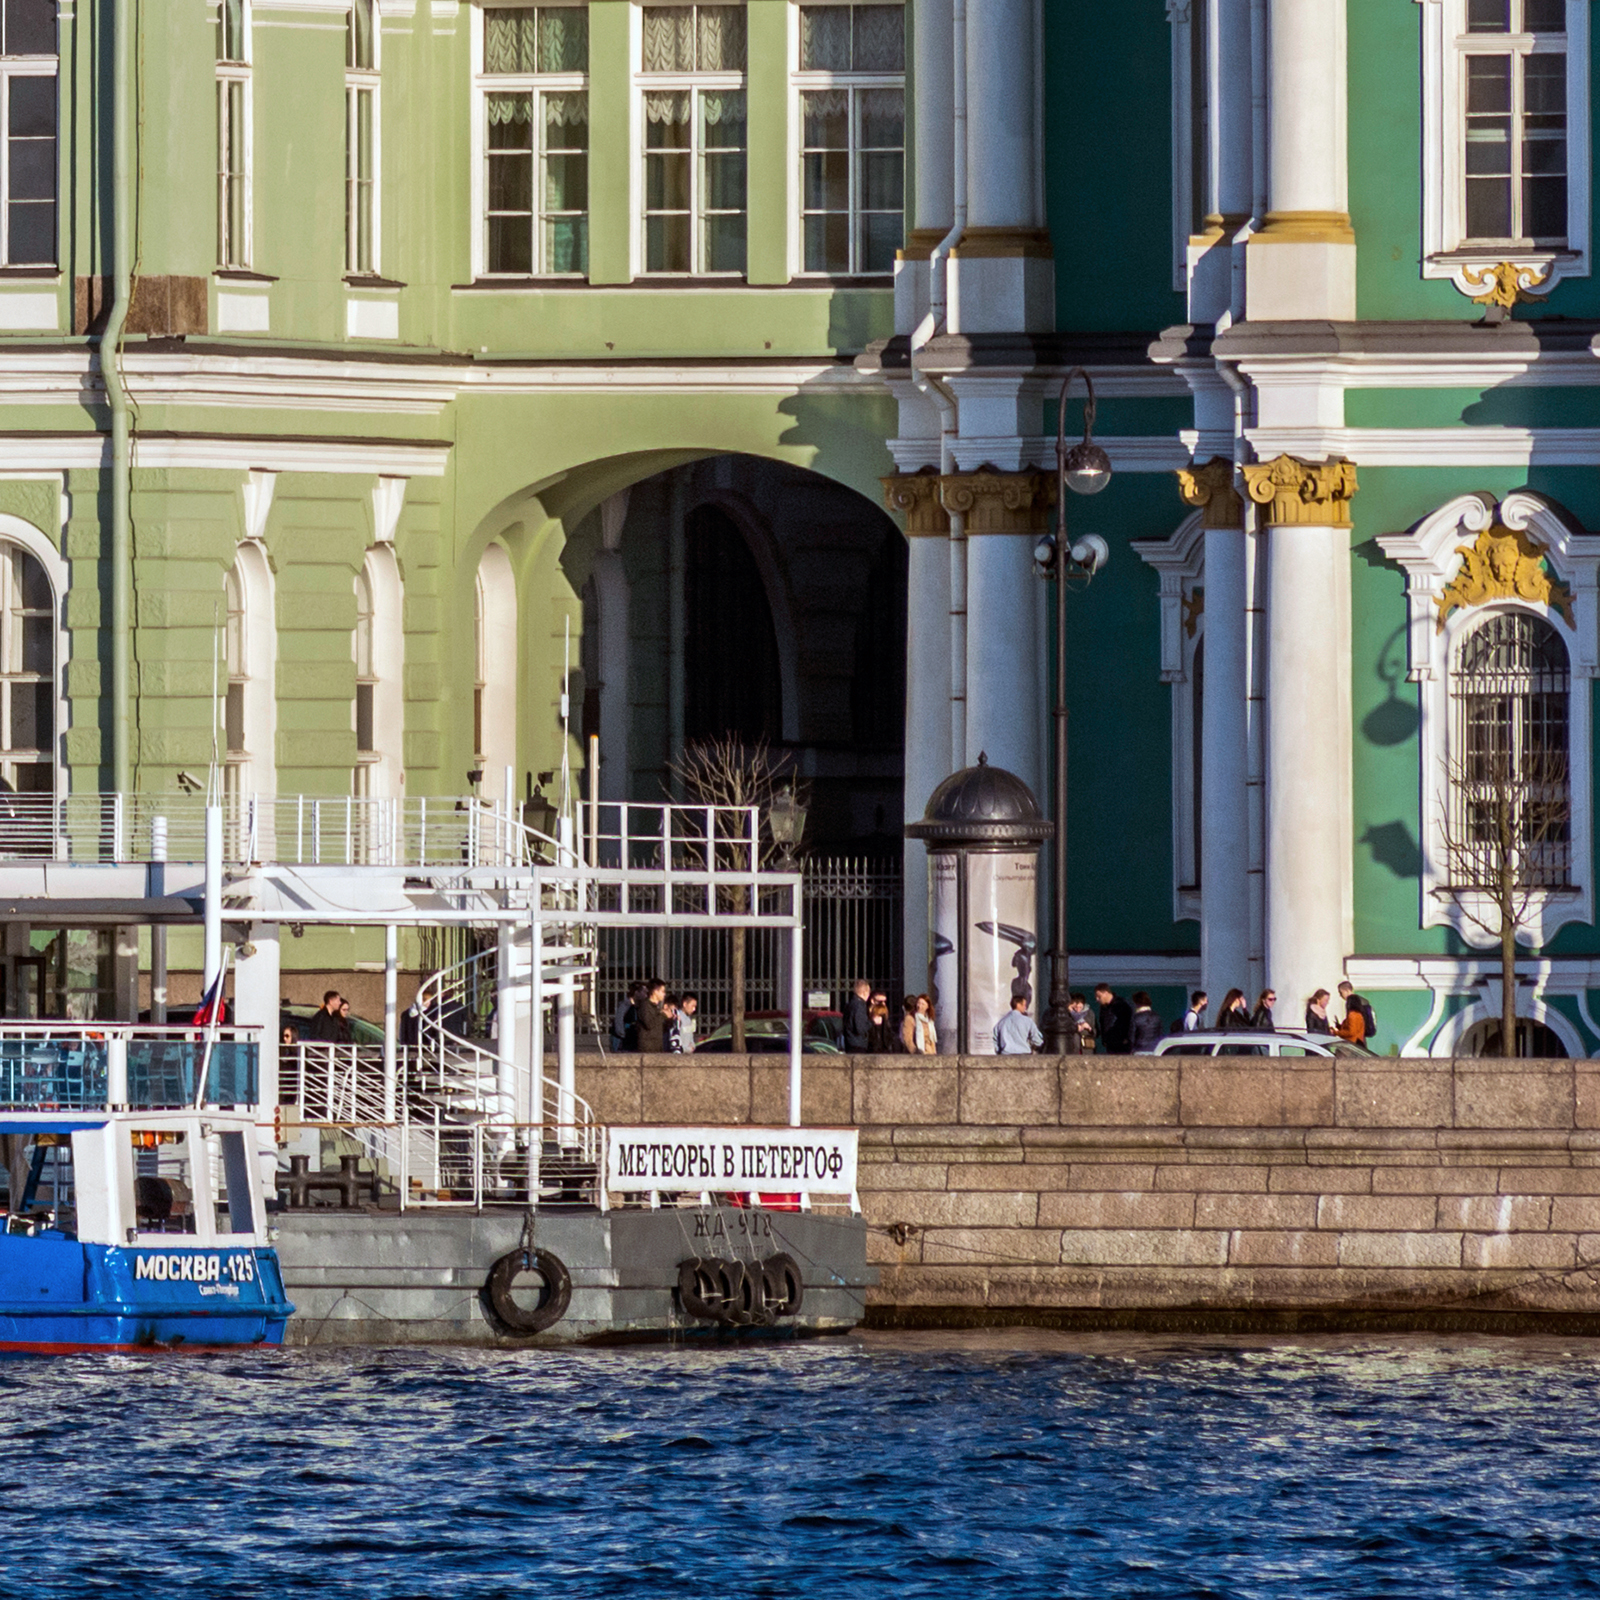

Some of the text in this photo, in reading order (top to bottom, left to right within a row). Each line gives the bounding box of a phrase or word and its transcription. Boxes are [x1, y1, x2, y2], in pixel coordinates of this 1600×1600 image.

[618, 1144, 843, 1180] МЕТЕОРЫ В ПЕТЕРГОФ
[693, 1212, 773, 1240] ЖД-918
